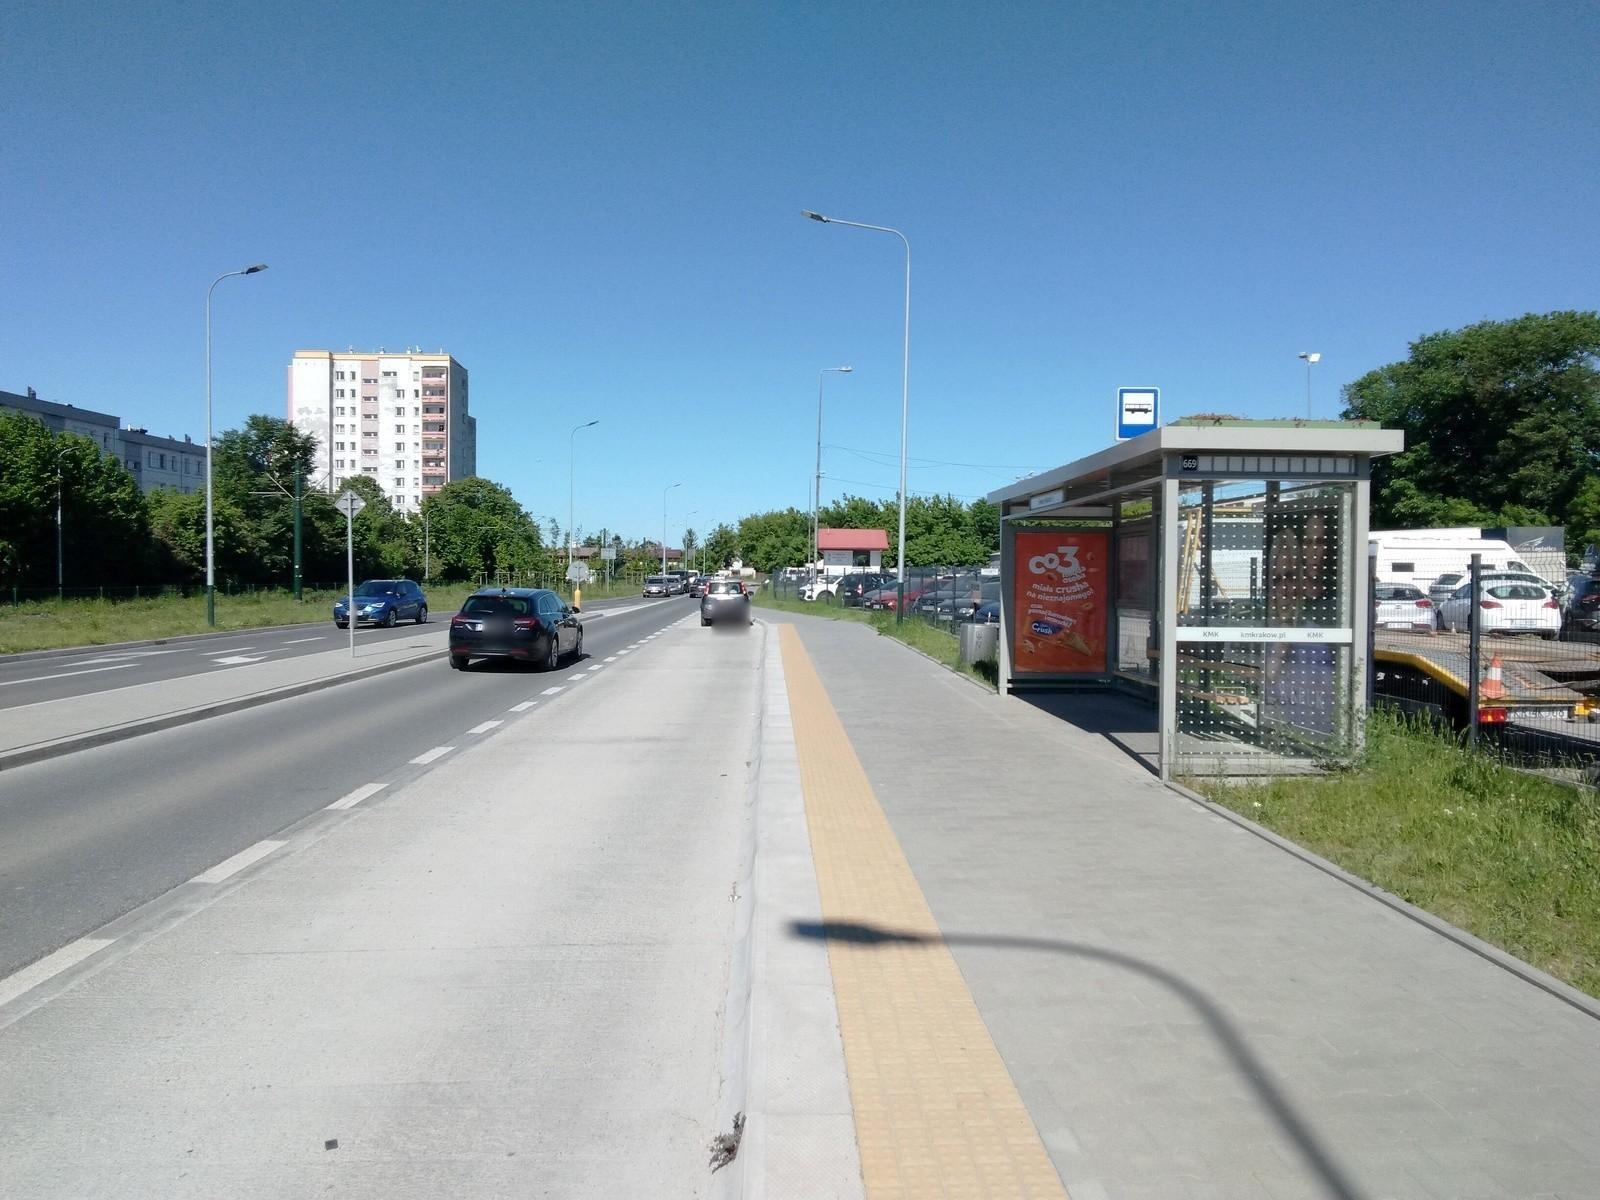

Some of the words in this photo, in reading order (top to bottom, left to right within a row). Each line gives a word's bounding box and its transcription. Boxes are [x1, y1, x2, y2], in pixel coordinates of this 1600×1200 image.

[1183, 459, 1197, 468] 669
[1026, 590, 1036, 598] na
[1032, 622, 1053, 635] Crush
[1240, 631, 1286, 639] kmkrakow.pl
